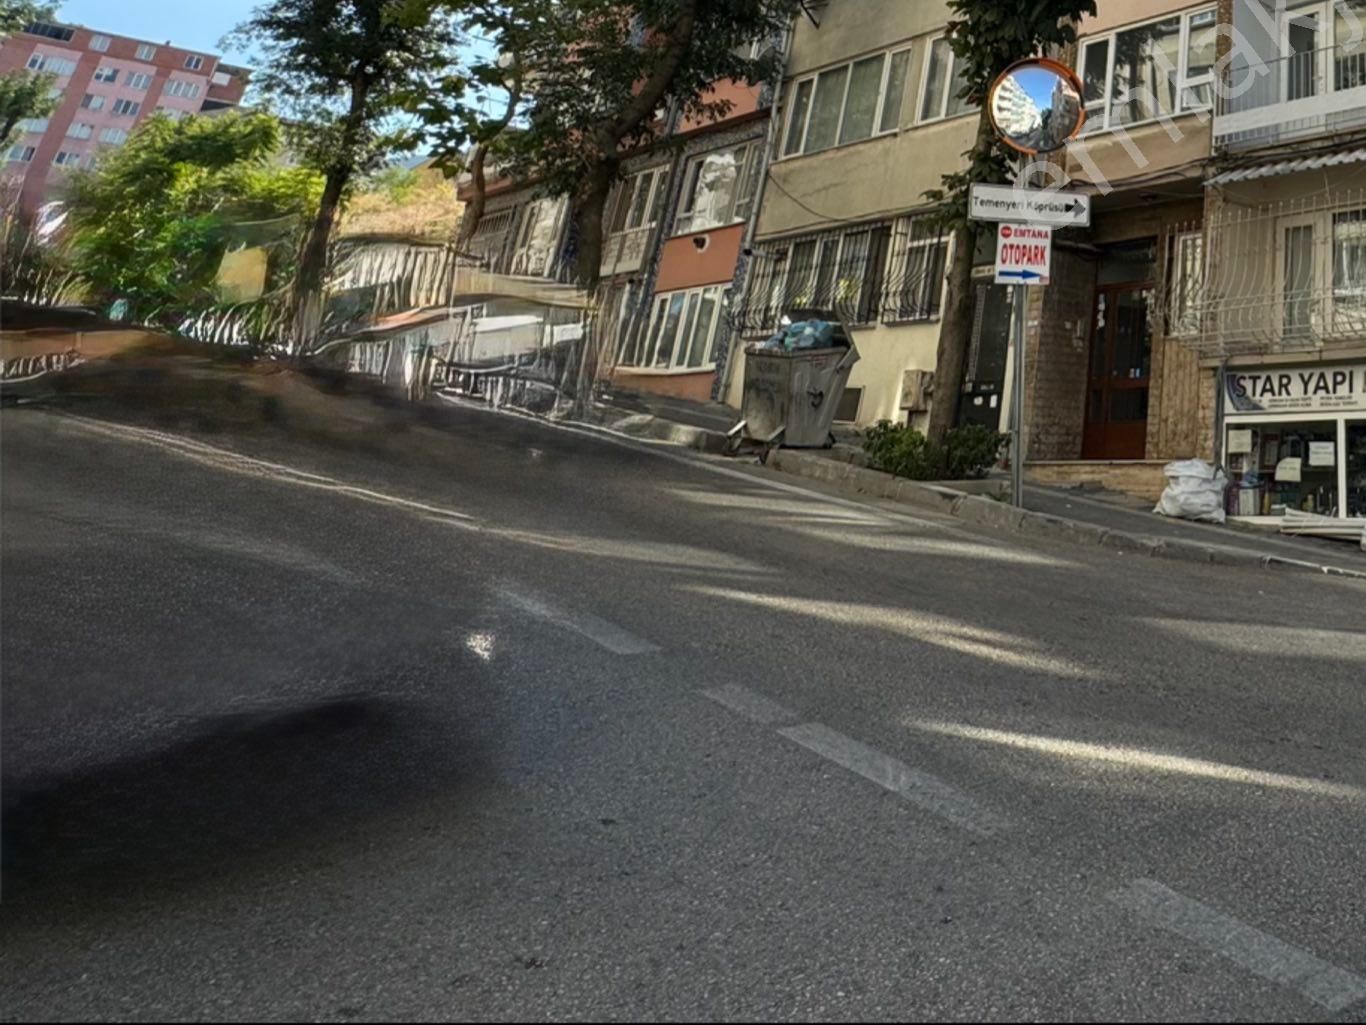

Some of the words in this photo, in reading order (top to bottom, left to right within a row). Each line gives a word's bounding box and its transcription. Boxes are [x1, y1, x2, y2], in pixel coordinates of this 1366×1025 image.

[974, 196, 1024, 210] Temenyeri
[1014, 228, 1049, 239] EMTANA
[1001, 243, 1047, 266] OTOPARK
[1235, 374, 1292, 398] STAR
[1298, 369, 1354, 395] YAPI
